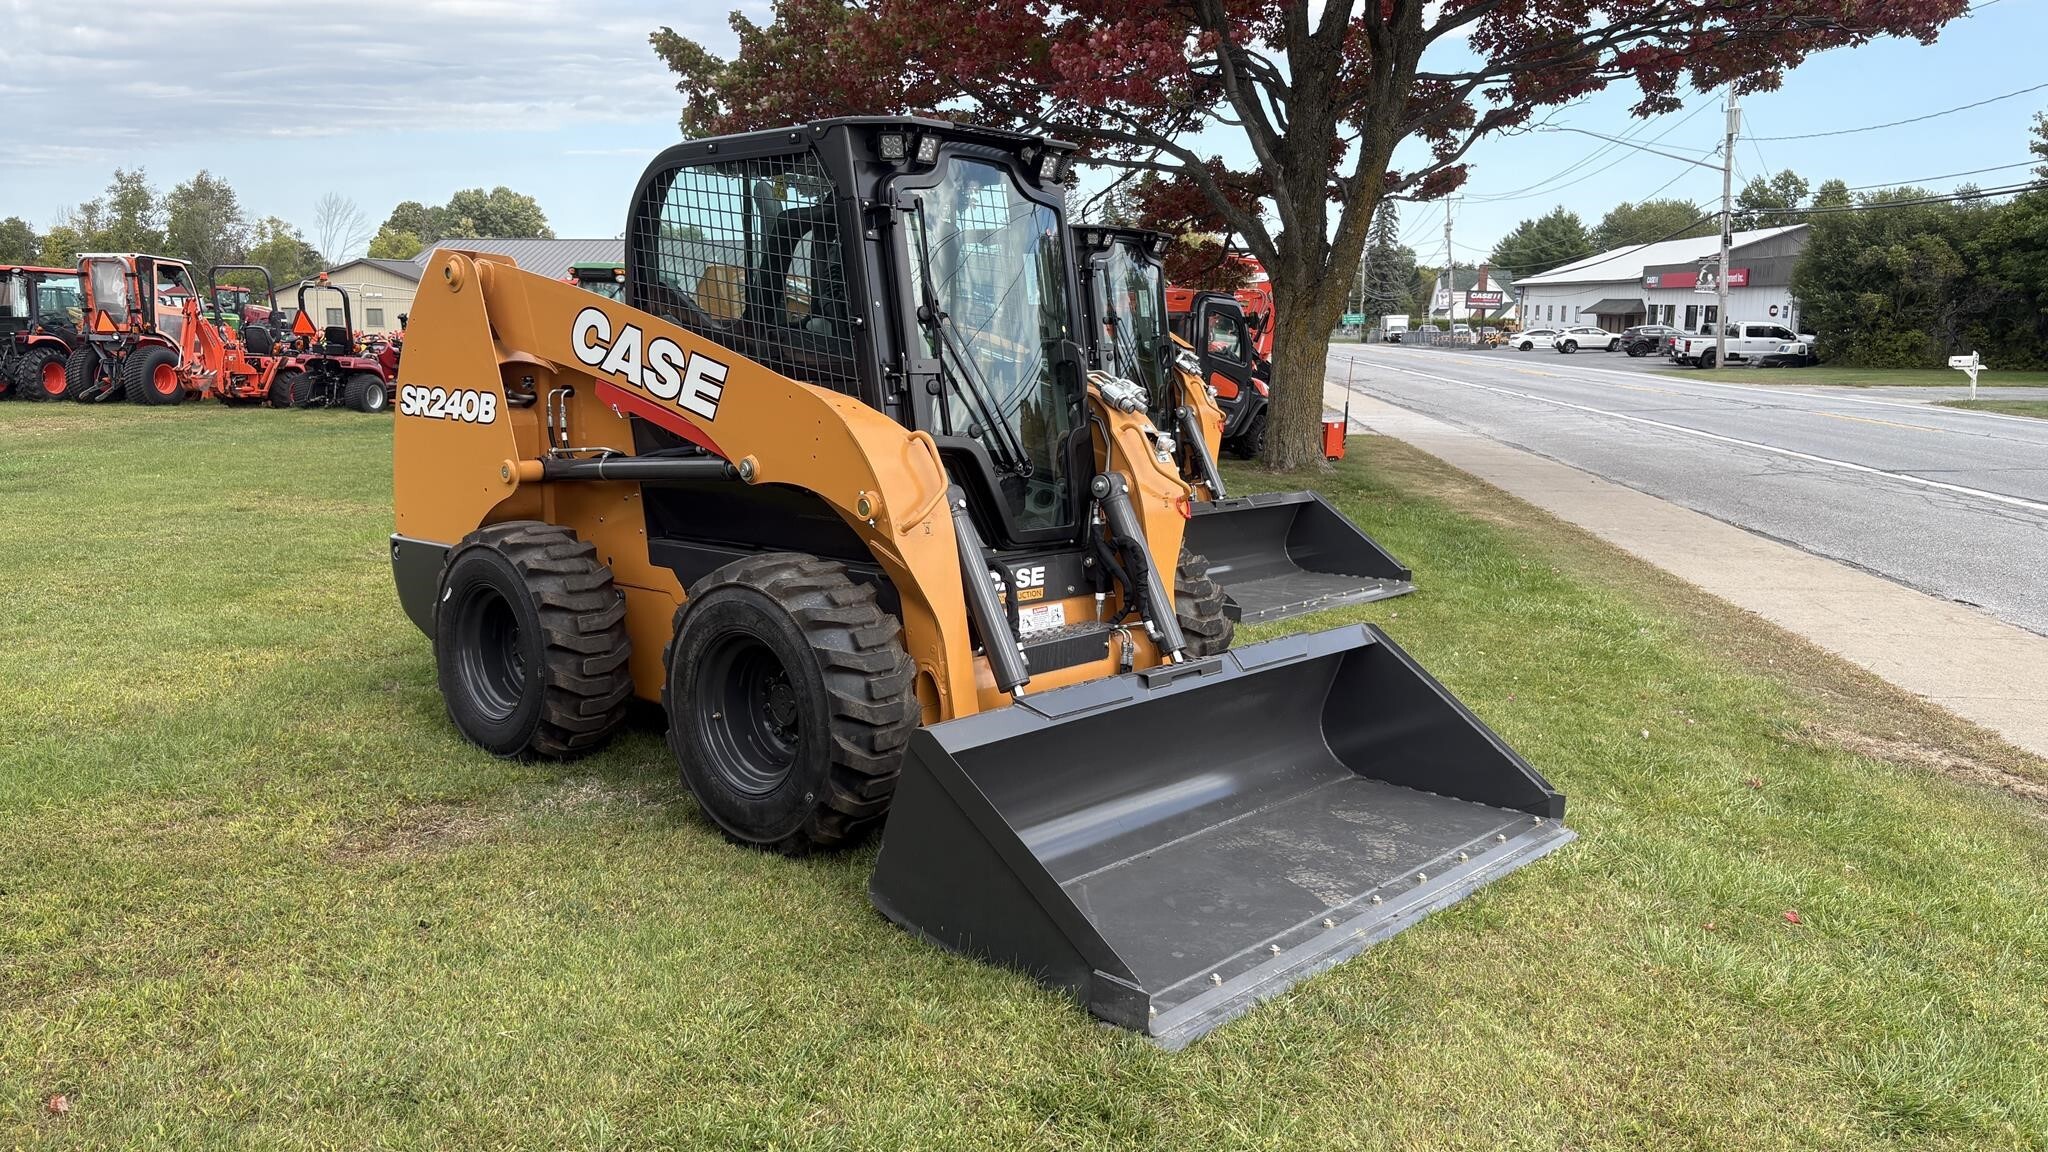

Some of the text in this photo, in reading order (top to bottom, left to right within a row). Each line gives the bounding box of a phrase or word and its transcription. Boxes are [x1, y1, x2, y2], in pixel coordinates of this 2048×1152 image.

[571, 306, 730, 421] CASE
[400, 384, 497, 424] SR240B
[990, 566, 1046, 591] CSE
